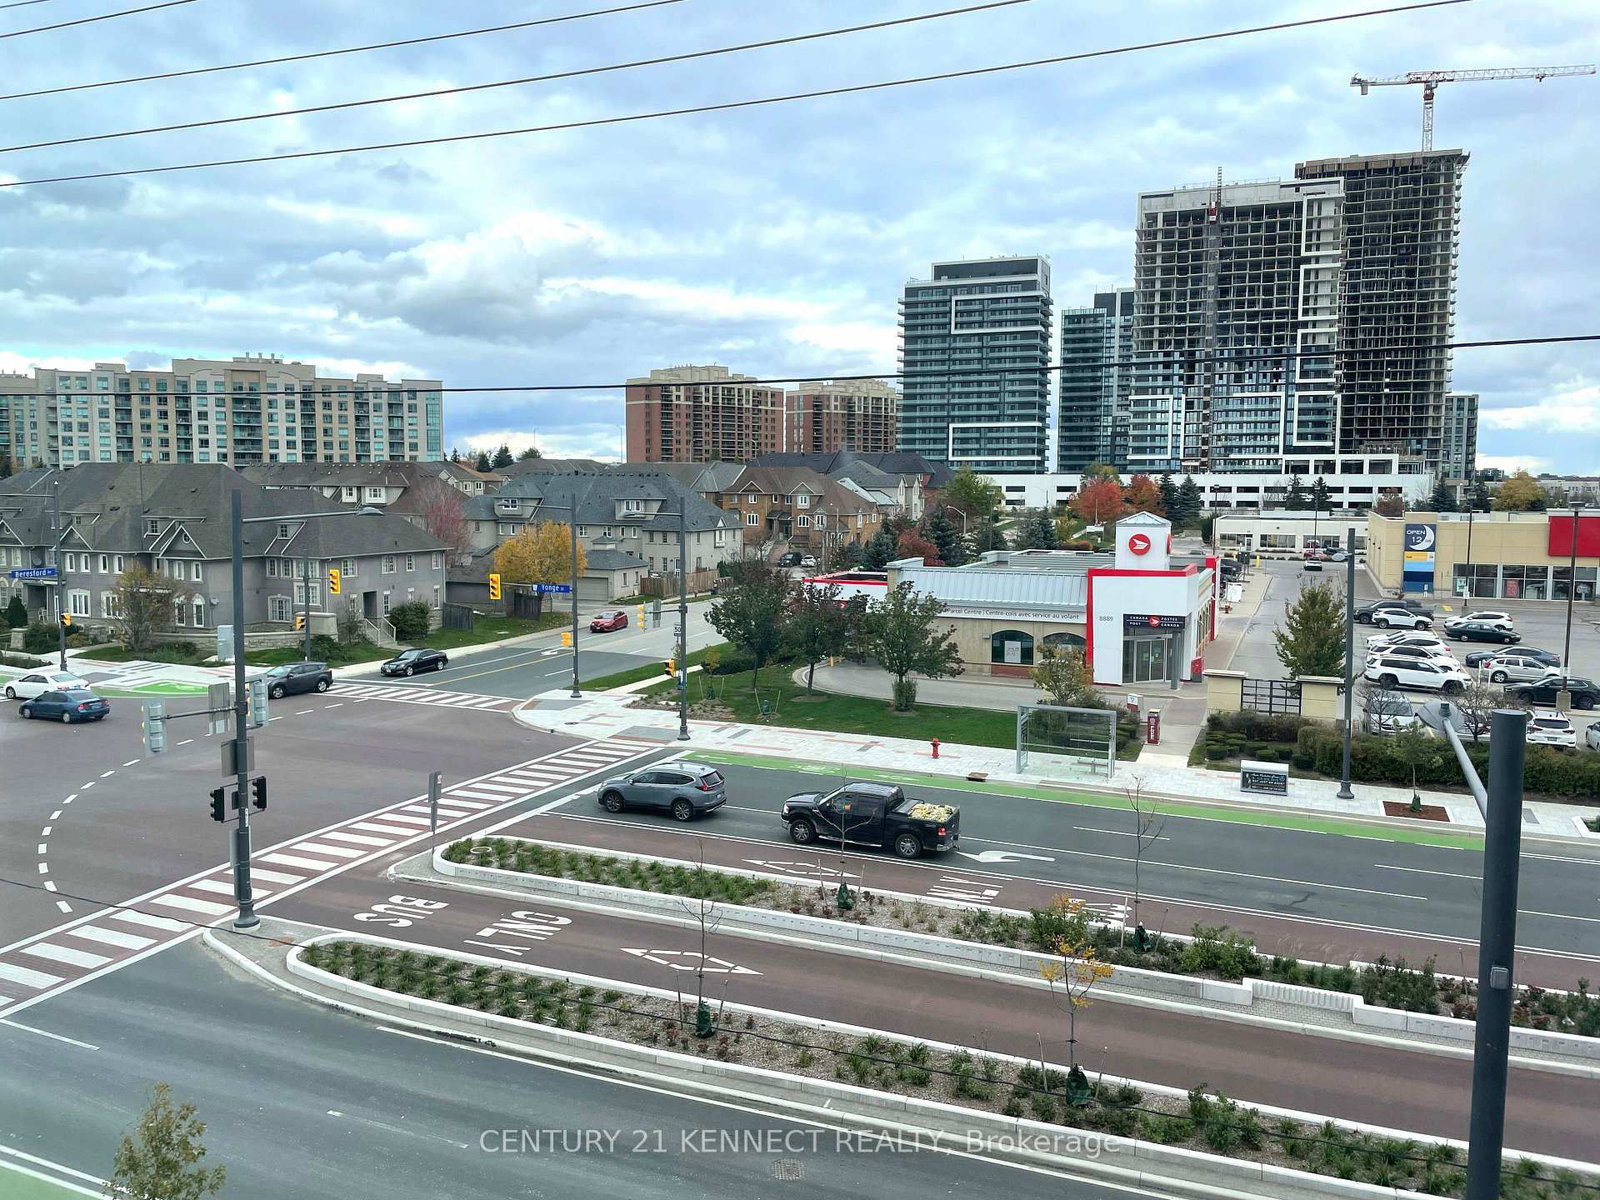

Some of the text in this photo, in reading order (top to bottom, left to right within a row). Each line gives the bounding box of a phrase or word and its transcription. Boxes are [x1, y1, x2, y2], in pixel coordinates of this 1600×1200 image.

[16, 570, 46, 578] Beresford
[353, 895, 450, 928] BUS
[463, 910, 573, 956] ONLY
